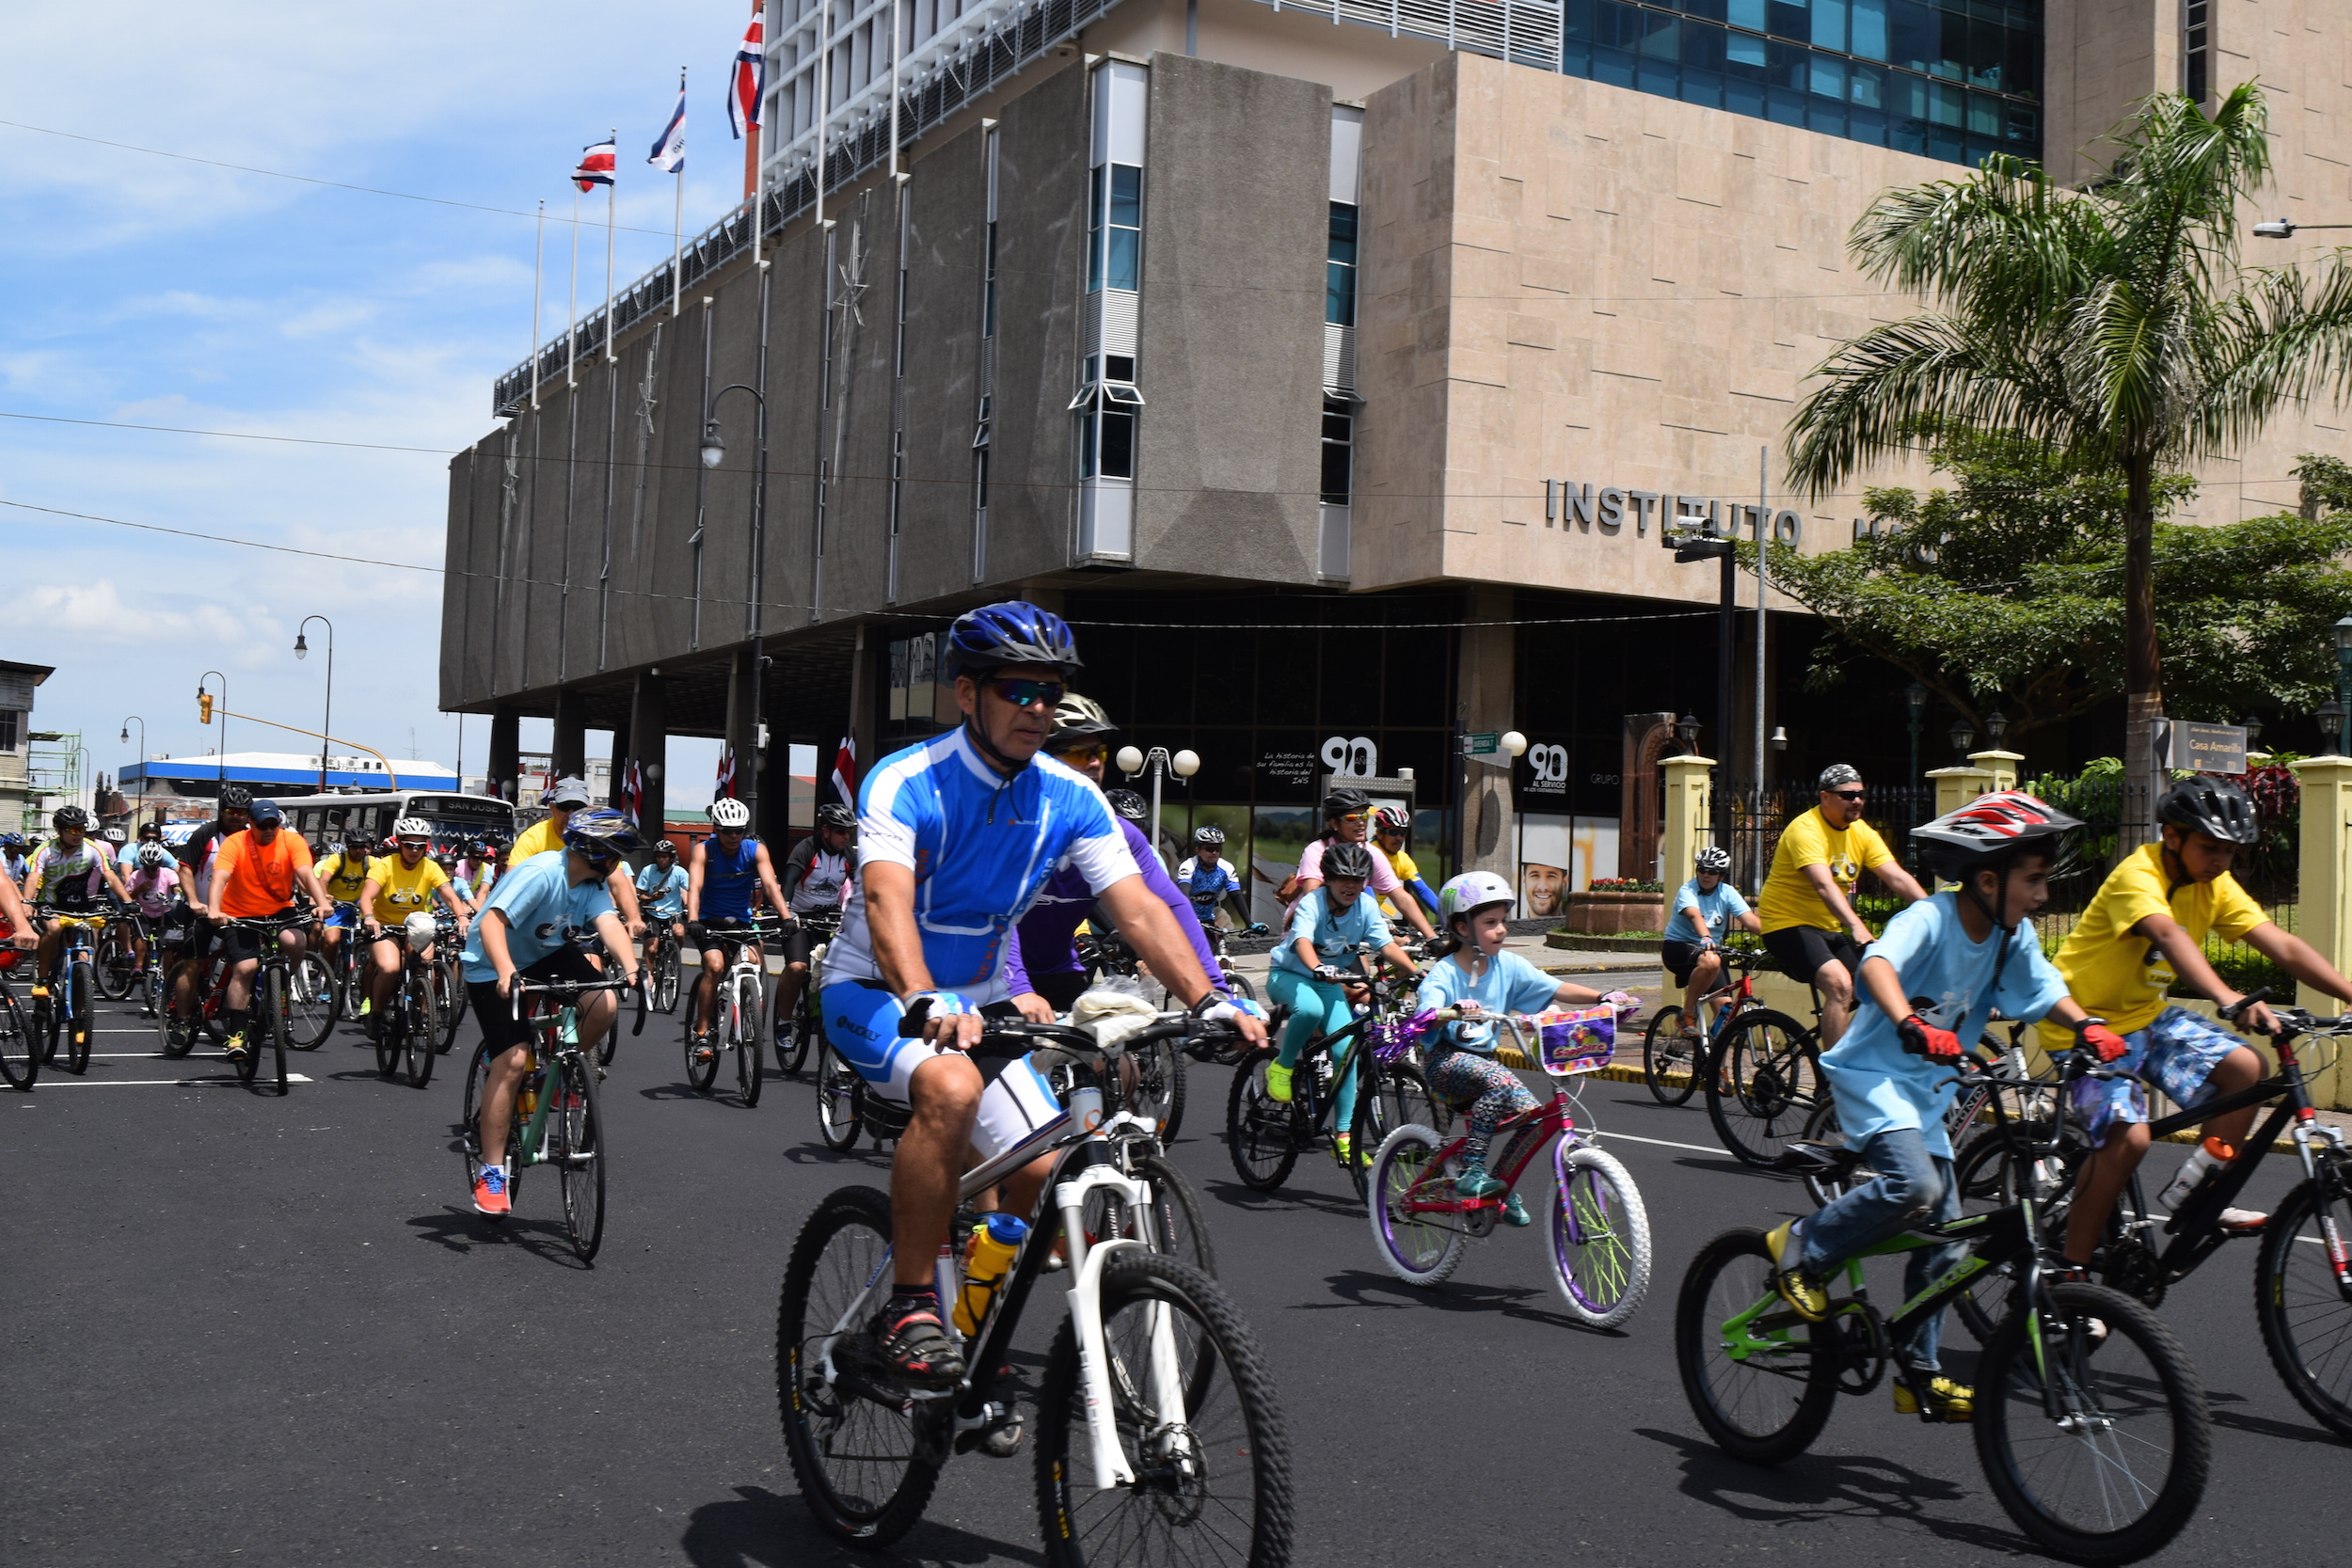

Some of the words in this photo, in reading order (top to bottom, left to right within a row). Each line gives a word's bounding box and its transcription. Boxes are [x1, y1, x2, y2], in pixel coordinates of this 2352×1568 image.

[1547, 479, 1802, 547] INSTITUTO
[2189, 738, 2209, 751] Casa
[2210, 741, 2243, 753] Amarilla
[1268, 760, 1295, 768] familia
[1321, 736, 1377, 778] 90
[1528, 742, 1568, 782] 90
[1269, 768, 1300, 776] historia
[1300, 768, 1313, 776] del
[1590, 772, 1620, 785] GRUPO
[1292, 776, 1310, 784] INS
[1533, 780, 1540, 788] AL
[1540, 780, 1567, 789] SERVICIO
[448, 800, 469, 810] SAN
[471, 803, 499, 814] JOSE
[46, 857, 89, 878] BIKE
[1554, 1043, 1605, 1057] Sapphire
